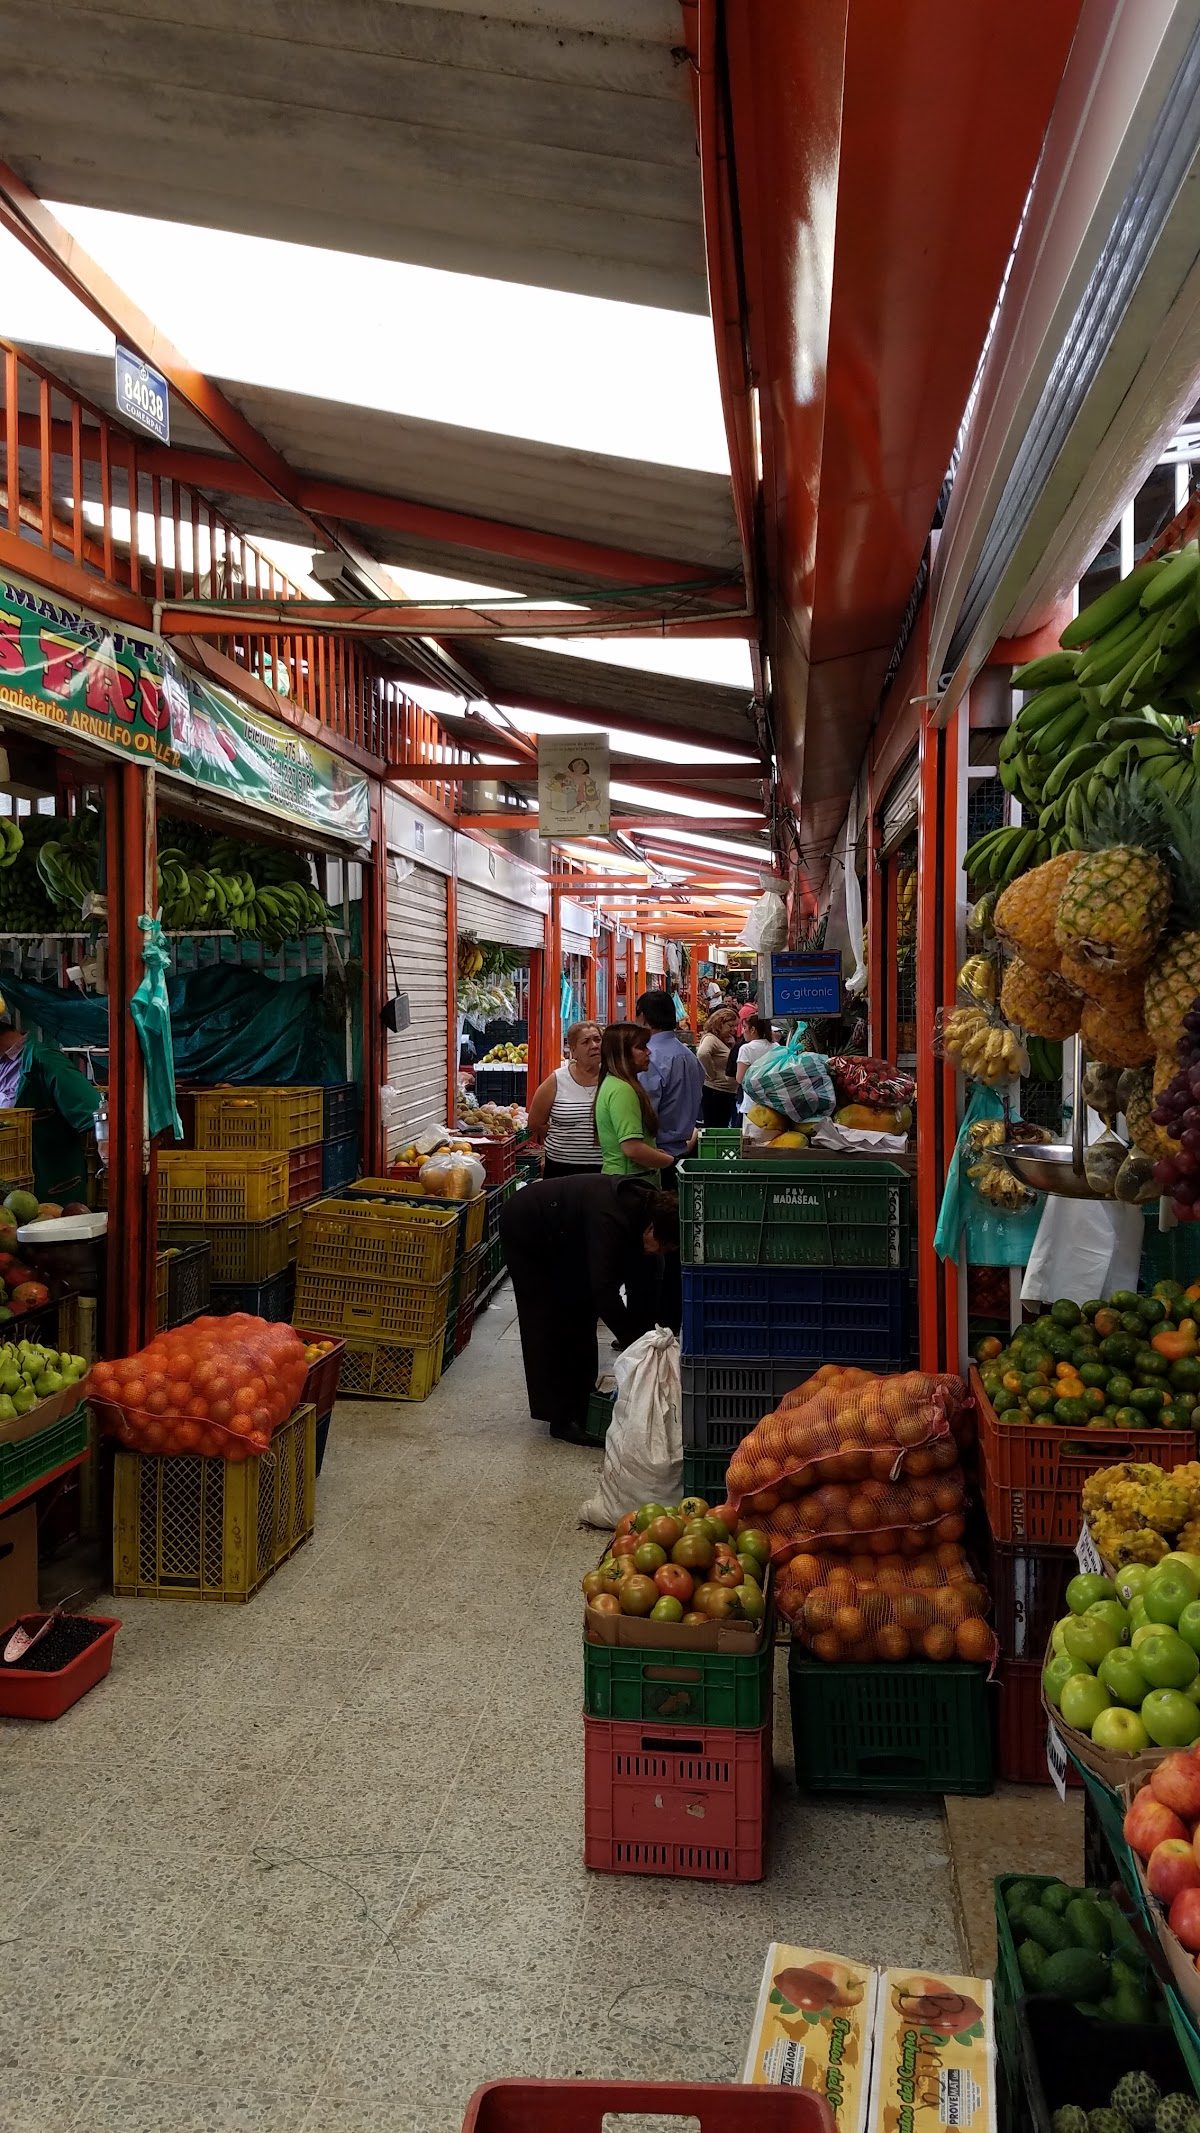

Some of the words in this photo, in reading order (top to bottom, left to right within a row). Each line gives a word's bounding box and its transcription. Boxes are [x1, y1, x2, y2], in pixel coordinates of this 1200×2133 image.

[124, 373, 163, 422] 84038
[71, 711, 131, 746] ARNULFO
[793, 987, 833, 1000] gitronic
[773, 1194, 820, 1206] MADASEAL
[829, 2016, 850, 2066] Frutos
[896, 2029, 922, 2079] Campo
[826, 2067, 845, 2093] del
[896, 2077, 916, 2104] del
[948, 2080, 960, 2125] PROVEMAT
